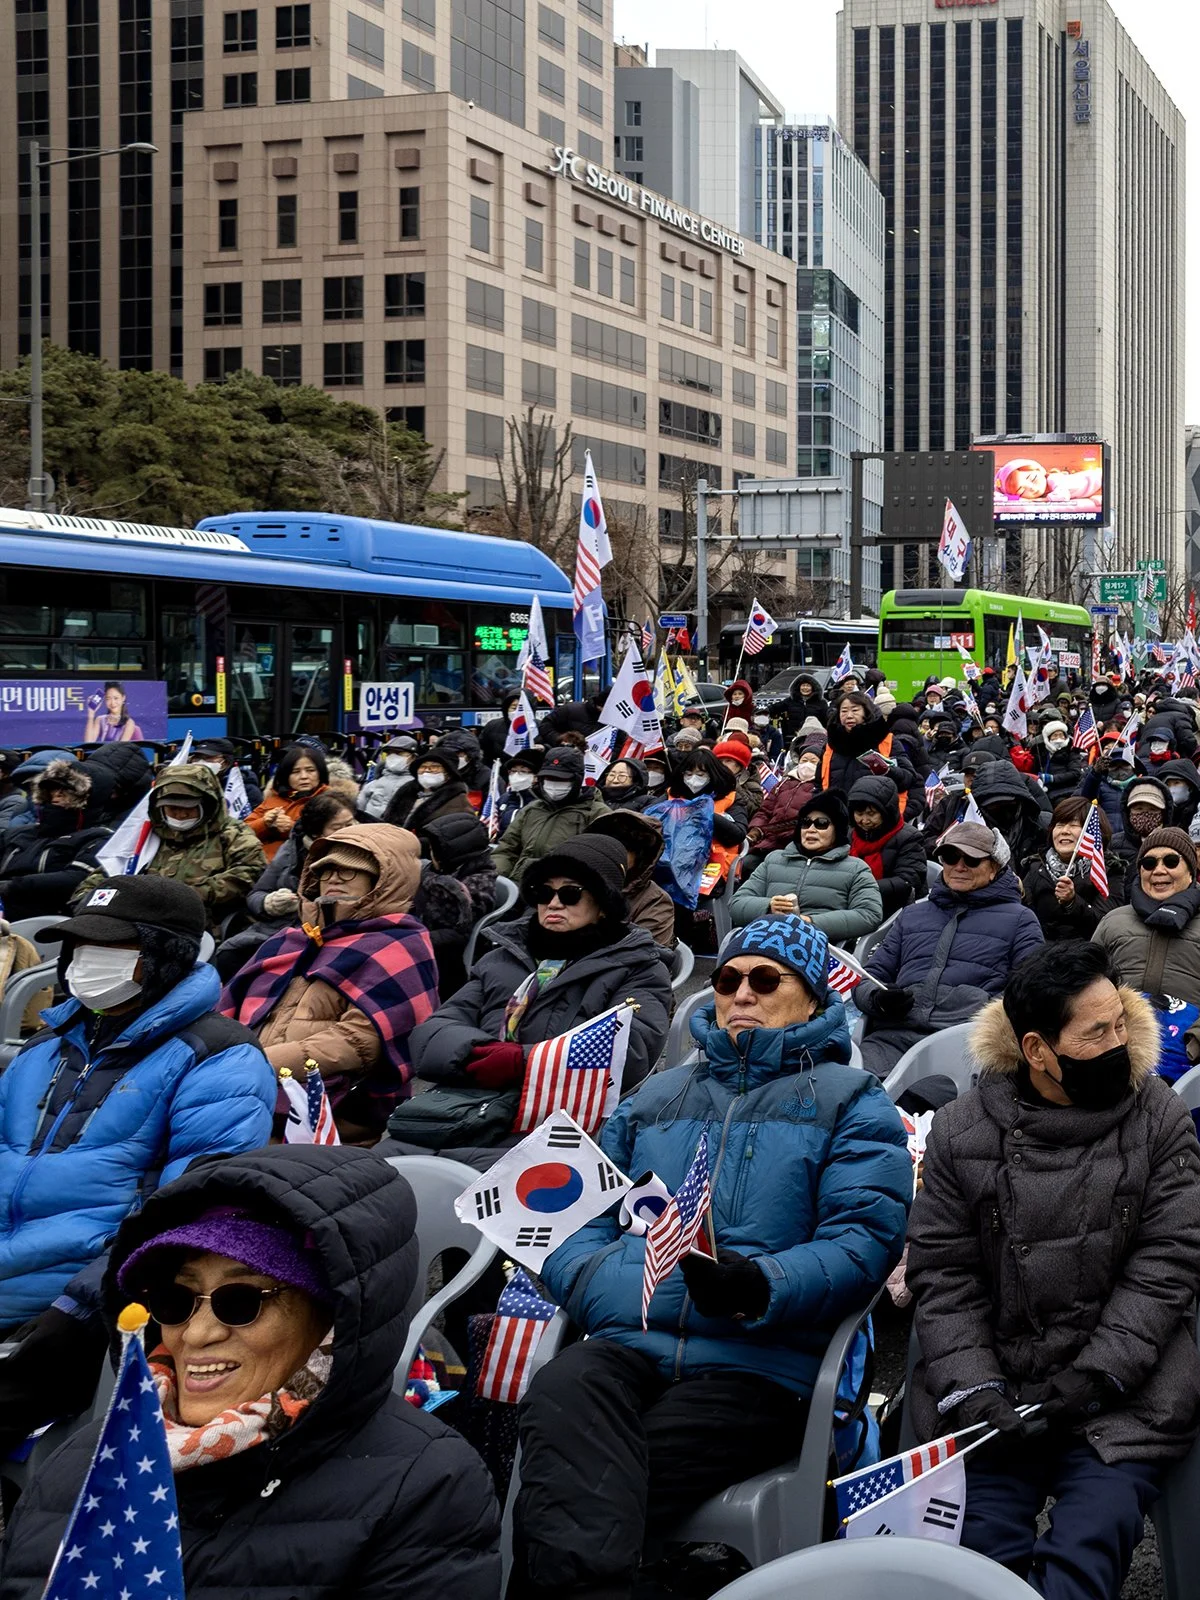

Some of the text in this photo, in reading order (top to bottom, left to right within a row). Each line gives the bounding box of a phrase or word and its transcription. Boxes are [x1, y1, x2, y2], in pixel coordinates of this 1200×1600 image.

[1072, 40, 1091, 125] 서울신문
[585, 162, 639, 207] SEOUL
[639, 189, 700, 236] FINANCE
[700, 220, 746, 257] CENTER
[509, 612, 530, 624] 9365
[0, 687, 85, 713] 면 바비톡
[365, 687, 410, 721] 안성1
[735, 919, 827, 967] ORTH
[785, 913, 828, 946] THE
[741, 931, 822, 985] FACE
